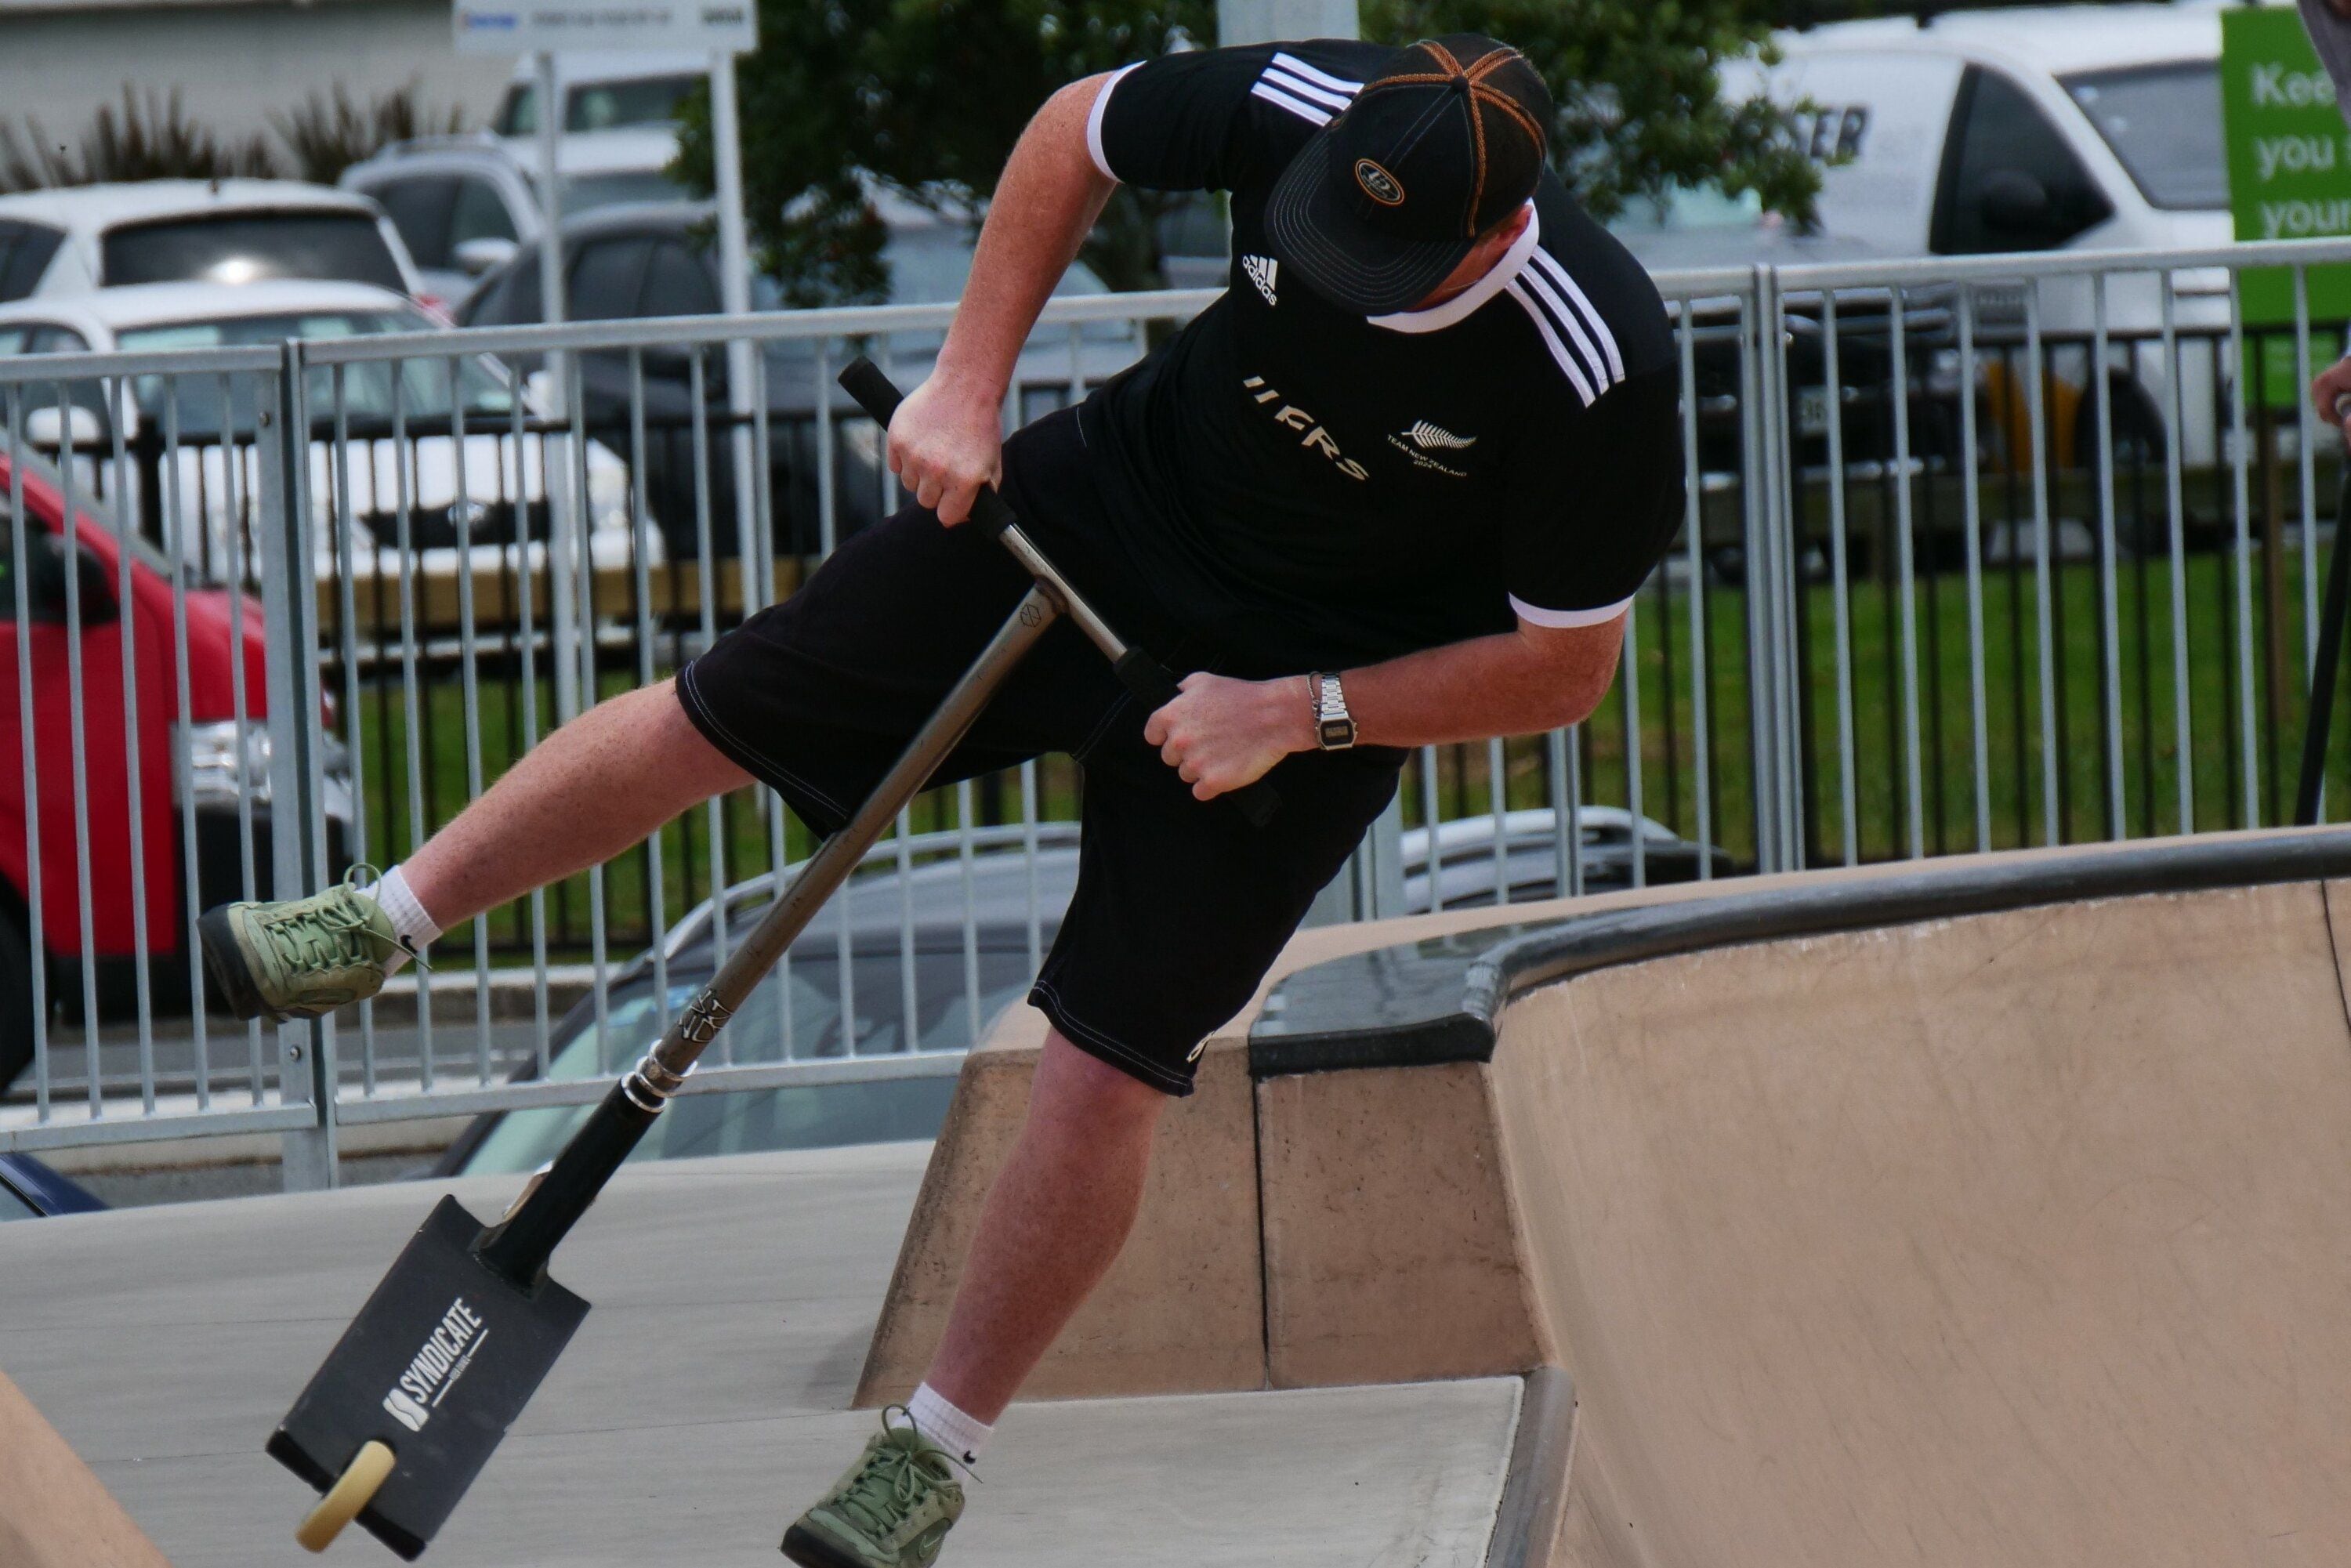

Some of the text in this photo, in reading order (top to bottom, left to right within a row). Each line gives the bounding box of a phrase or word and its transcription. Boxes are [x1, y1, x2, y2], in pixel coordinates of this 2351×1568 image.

[2251, 61, 2336, 106] Kee
[2255, 136, 2335, 180] you
[1243, 255, 1277, 306] adidas
[1388, 434, 1467, 476] TEAM NEW ZEALAND
[1413, 459, 1433, 469] 2024
[400, 1297, 482, 1404] SYNDICATE
